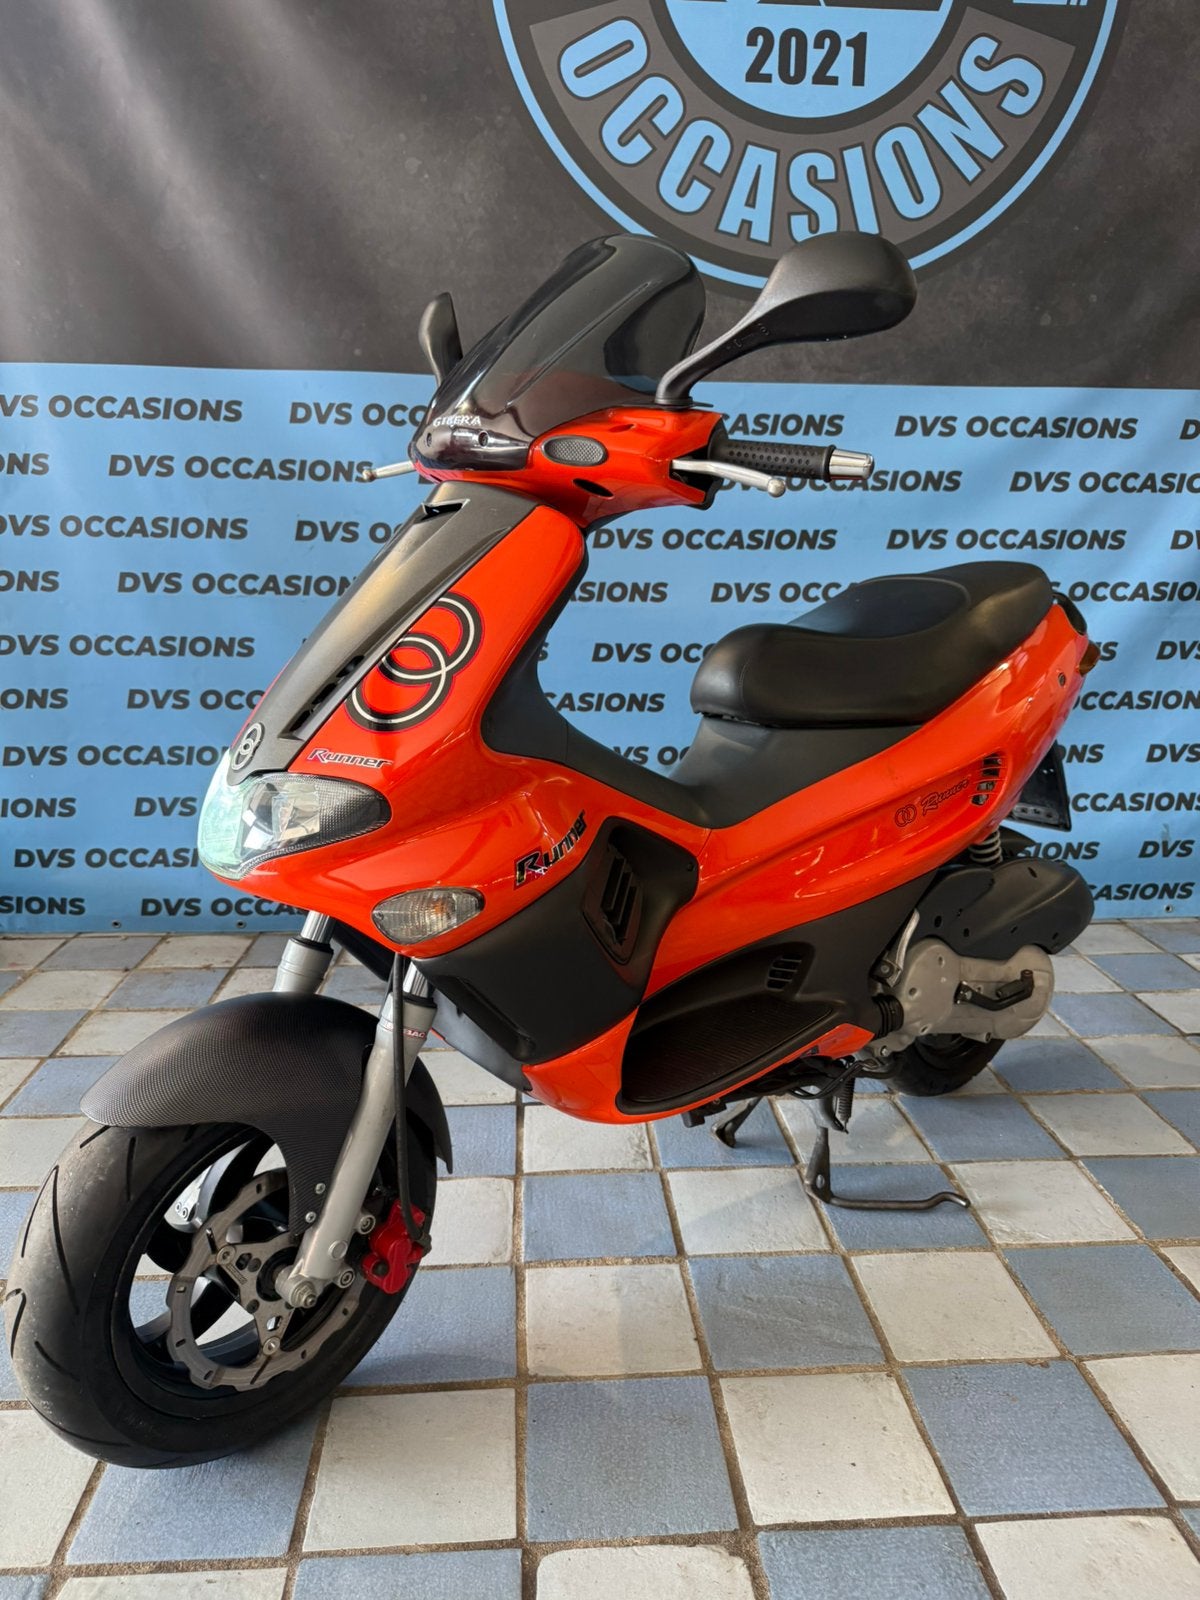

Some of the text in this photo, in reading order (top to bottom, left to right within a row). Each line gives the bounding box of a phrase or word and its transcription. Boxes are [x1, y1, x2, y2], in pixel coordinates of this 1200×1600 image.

[745, 27, 867, 86] 2021
[559, 17, 1046, 244] OCCASIONS
[0, 395, 242, 422] VS OCCASIONS
[290, 402, 352, 425] DVS
[723, 413, 845, 436] ASIONS
[895, 416, 1138, 439] DVS OCCASIONS
[109, 455, 373, 483] DVS OCCASIONS
[1010, 472, 1200, 493] DVS OCCASIO
[60, 516, 248, 540] OCCASIONS
[295, 520, 359, 543] DVS
[593, 529, 837, 550] DVS OCCASIONS
[887, 529, 1126, 550] DVS OCCASIONS
[118, 572, 182, 593] DVS
[568, 582, 669, 603] SIONS
[711, 583, 771, 603] DVS
[1068, 580, 1200, 602] OCCASIO
[0, 635, 254, 657] DVS OCCASIONS
[592, 643, 652, 663] DVS
[127, 689, 189, 710] DVS
[545, 692, 666, 712] ASIONS
[1073, 690, 1200, 710] CCASION
[3, 746, 228, 766] DVS OCCASIO
[308, 748, 393, 769] Runner
[1146, 744, 1200, 762] DVS
[134, 797, 196, 817] DVS
[1071, 793, 1200, 812] CCASION
[14, 848, 198, 868] DVS OCCASI
[515, 810, 587, 887] Runner
[1139, 840, 1194, 858] DVS
[1088, 882, 1196, 901] ASIONS
[0, 896, 85, 915] SIONS
[141, 898, 201, 916] DVS
